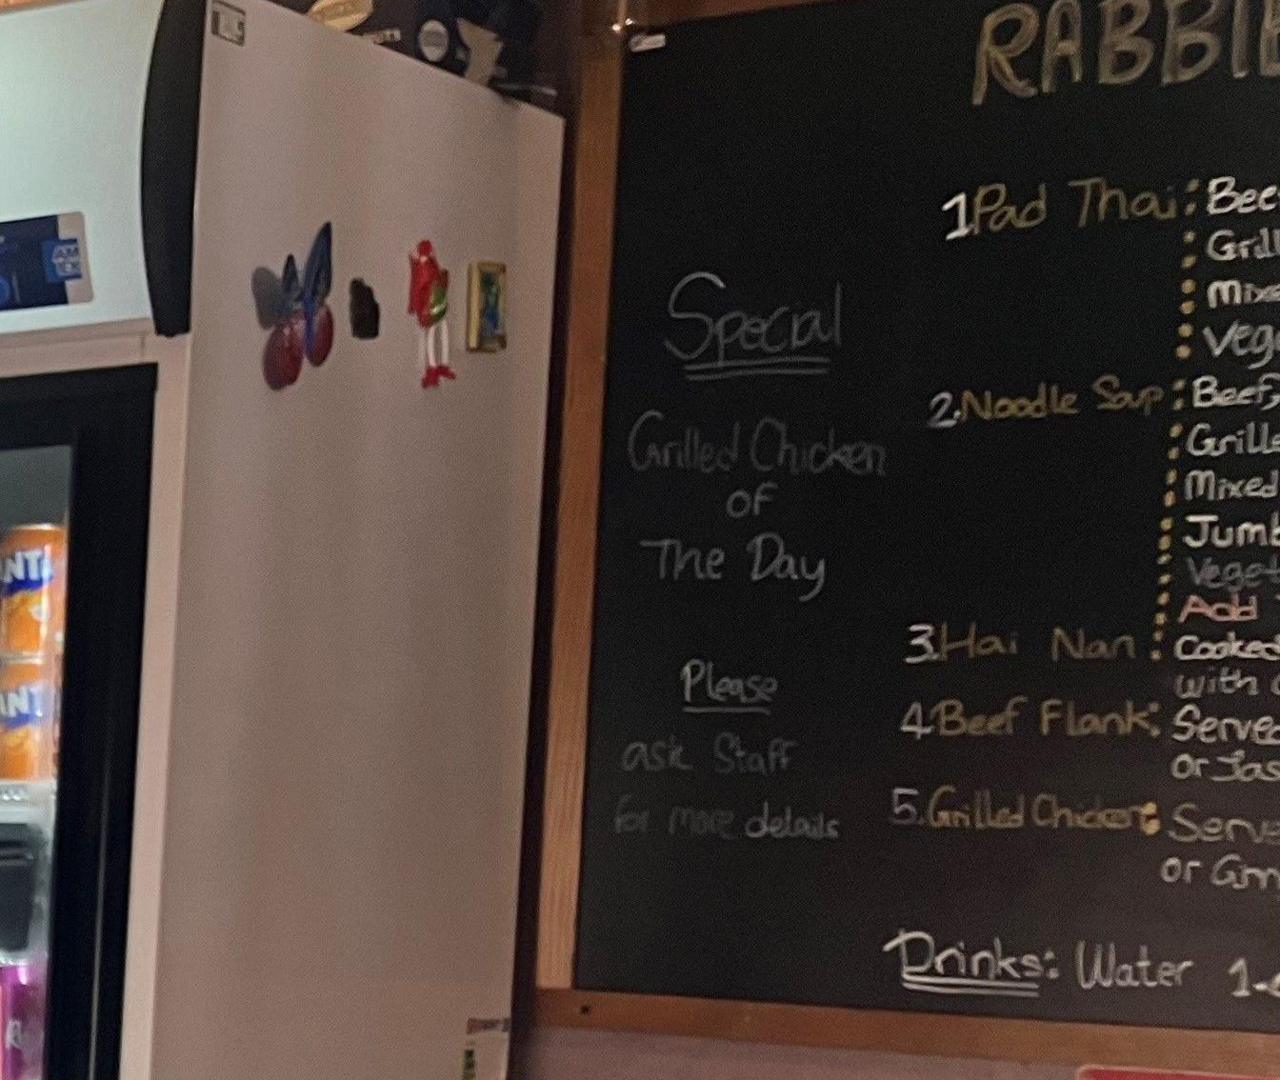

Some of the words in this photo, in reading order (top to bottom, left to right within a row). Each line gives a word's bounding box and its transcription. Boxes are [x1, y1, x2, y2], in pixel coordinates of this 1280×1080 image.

[664, 271, 841, 367] Special
[1202, 320, 1280, 370] Veg
[1184, 469, 1279, 500] Mixed
[640, 538, 727, 580] The
[746, 532, 825, 602] Day
[1174, 664, 1259, 699] with
[744, 801, 840, 839] details
[1076, 940, 1194, 990] Water
